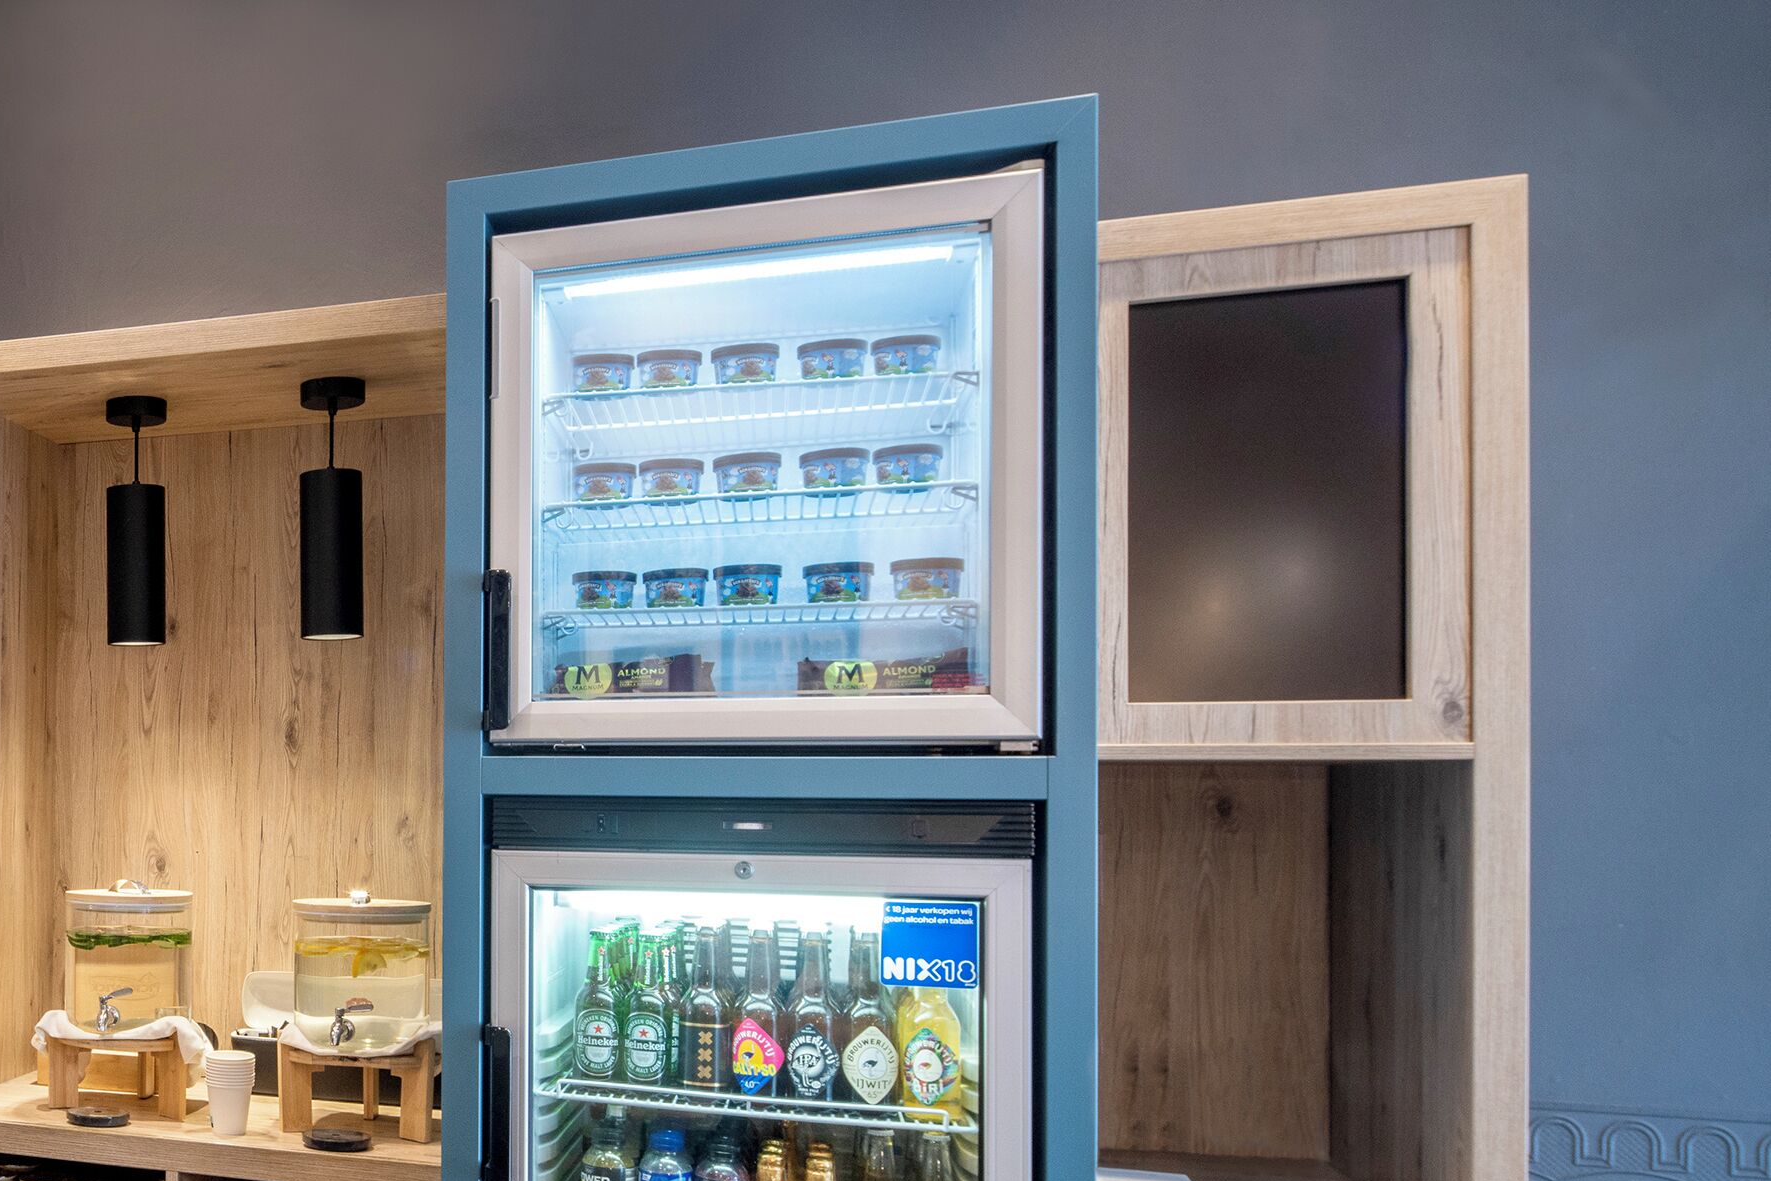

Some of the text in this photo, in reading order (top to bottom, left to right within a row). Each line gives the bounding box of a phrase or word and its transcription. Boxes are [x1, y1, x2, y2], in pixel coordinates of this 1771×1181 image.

[576, 665, 601, 685] M
[617, 667, 666, 677] ALMOND
[836, 663, 865, 683] M
[883, 664, 936, 676] ALMOND
[892, 905, 901, 913] 18
[901, 906, 918, 915] jaar
[919, 907, 959, 916] verkopen
[960, 908, 972, 916] wij
[883, 916, 905, 924] geen
[905, 915, 936, 924] alcohol
[949, 916, 974, 925] tabak
[883, 956, 976, 983] NIX18
[578, 1035, 619, 1047] Heineken
[625, 1039, 666, 1051] Heineken
[799, 1055, 817, 1066] IPA
[856, 1079, 888, 1089] IJWIT
